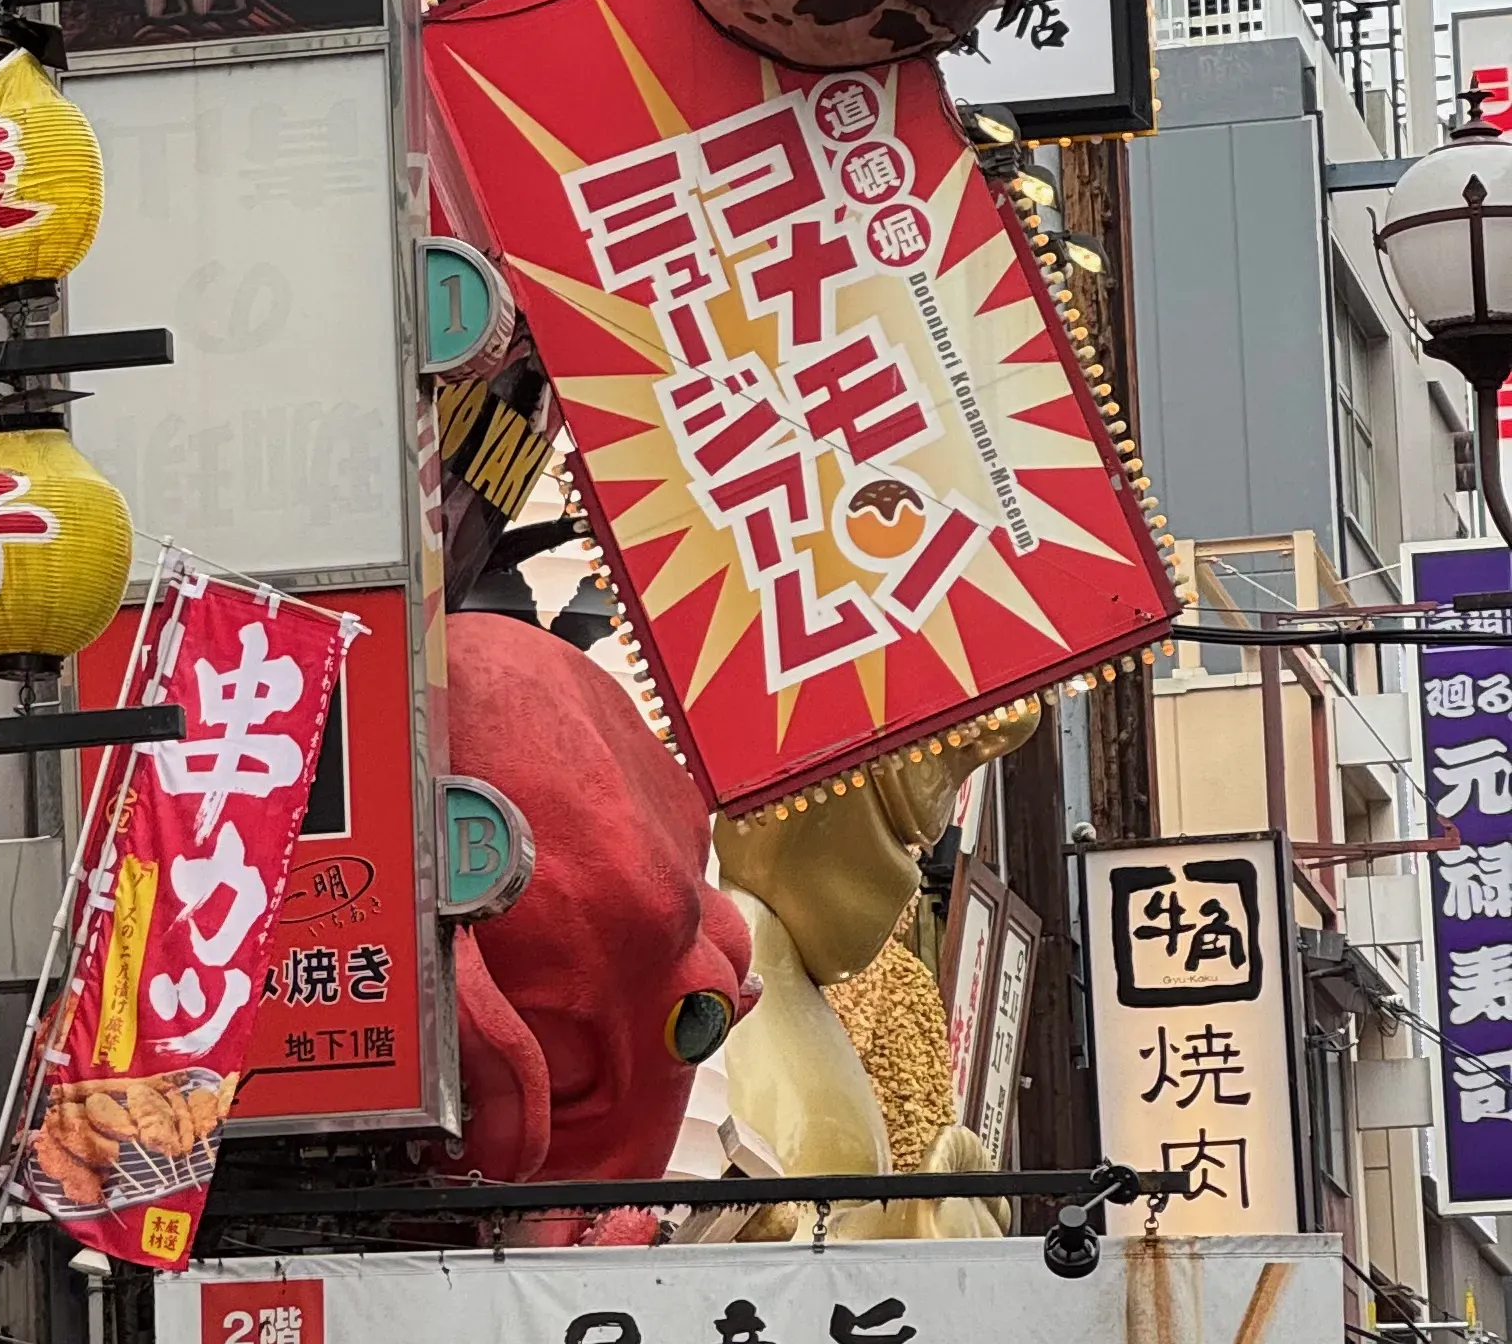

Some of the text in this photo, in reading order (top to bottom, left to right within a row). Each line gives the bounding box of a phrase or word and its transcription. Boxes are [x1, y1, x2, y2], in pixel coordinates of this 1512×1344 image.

[815, 78, 930, 263] 道頓堀
[441, 272, 469, 335] 1
[909, 271, 961, 369] Dotonbori
[570, 144, 886, 684] ミュージアム
[146, 622, 304, 1058] 串カツ
[455, 818, 497, 878] B
[1133, 889, 1246, 971] 牛角
[285, 1026, 396, 1063] 地下1階
[1138, 1022, 1252, 1209] 焼肉
